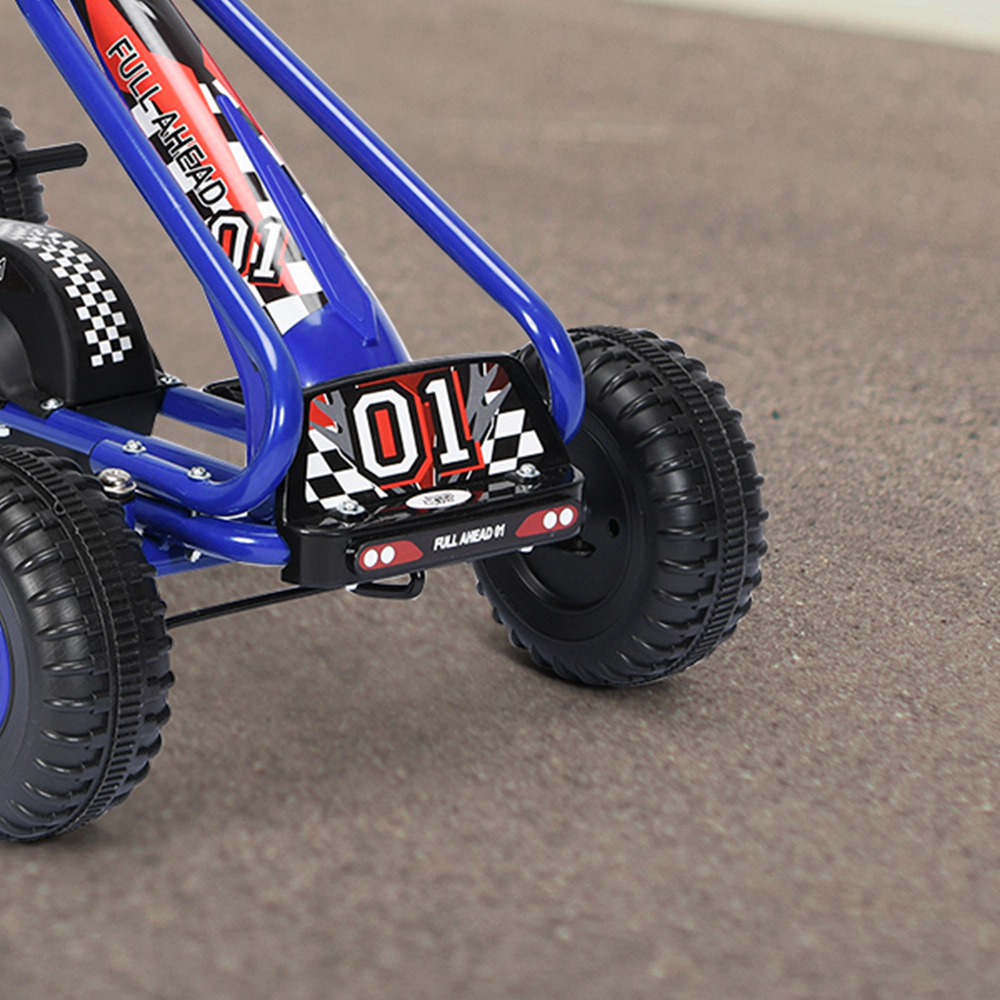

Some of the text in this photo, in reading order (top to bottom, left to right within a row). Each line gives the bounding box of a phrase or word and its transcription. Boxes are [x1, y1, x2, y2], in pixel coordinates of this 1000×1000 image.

[106, 36, 283, 285] FULL AHEAD 01
[352, 377, 471, 479] 01
[433, 533, 458, 551] FULL
[459, 526, 493, 546] AHEAD
